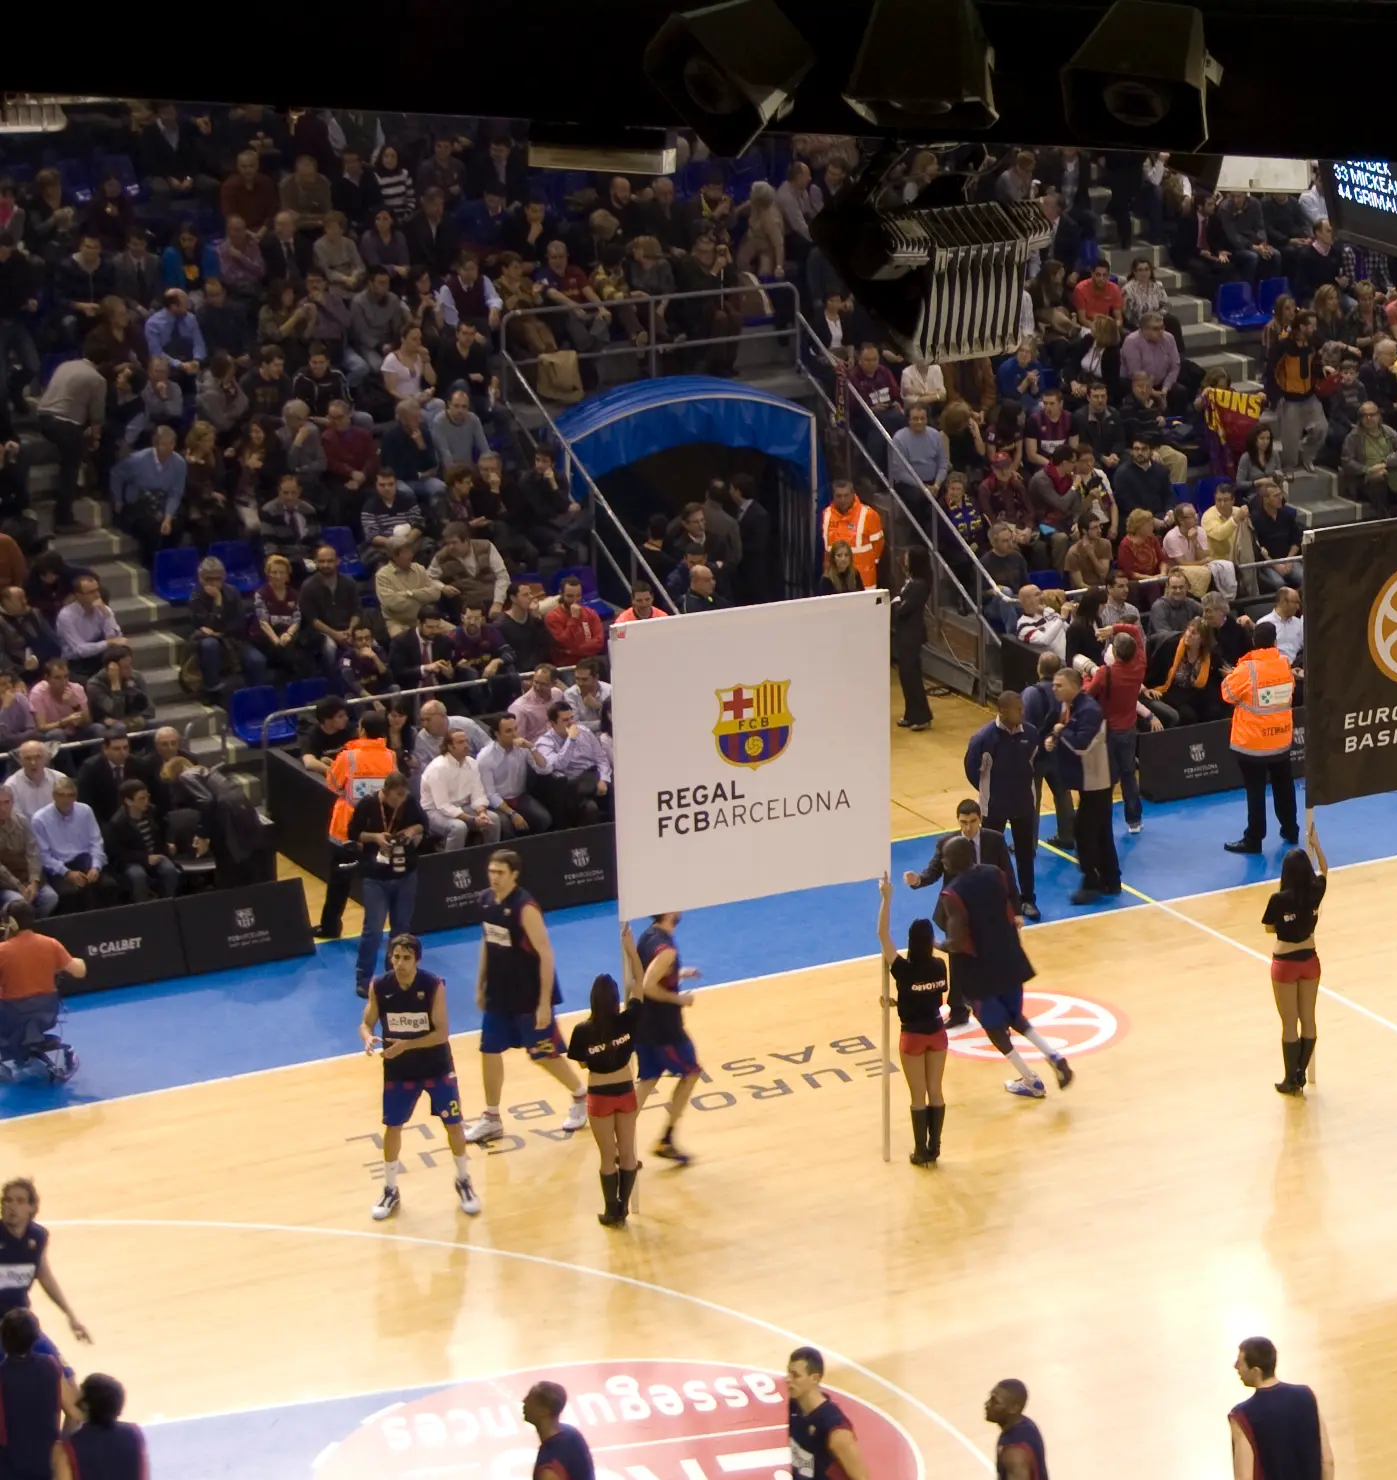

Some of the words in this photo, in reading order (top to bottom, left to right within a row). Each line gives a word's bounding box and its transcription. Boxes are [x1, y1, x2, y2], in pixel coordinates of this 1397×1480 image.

[1333, 164, 1348, 181] 33
[1338, 183, 1352, 200] 44
[738, 717, 770, 731] FCB
[657, 780, 745, 812] REGAL
[657, 789, 851, 838] FCBARCELONA
[99, 937, 142, 954] CALBET
[400, 1016, 428, 1031] Regal
